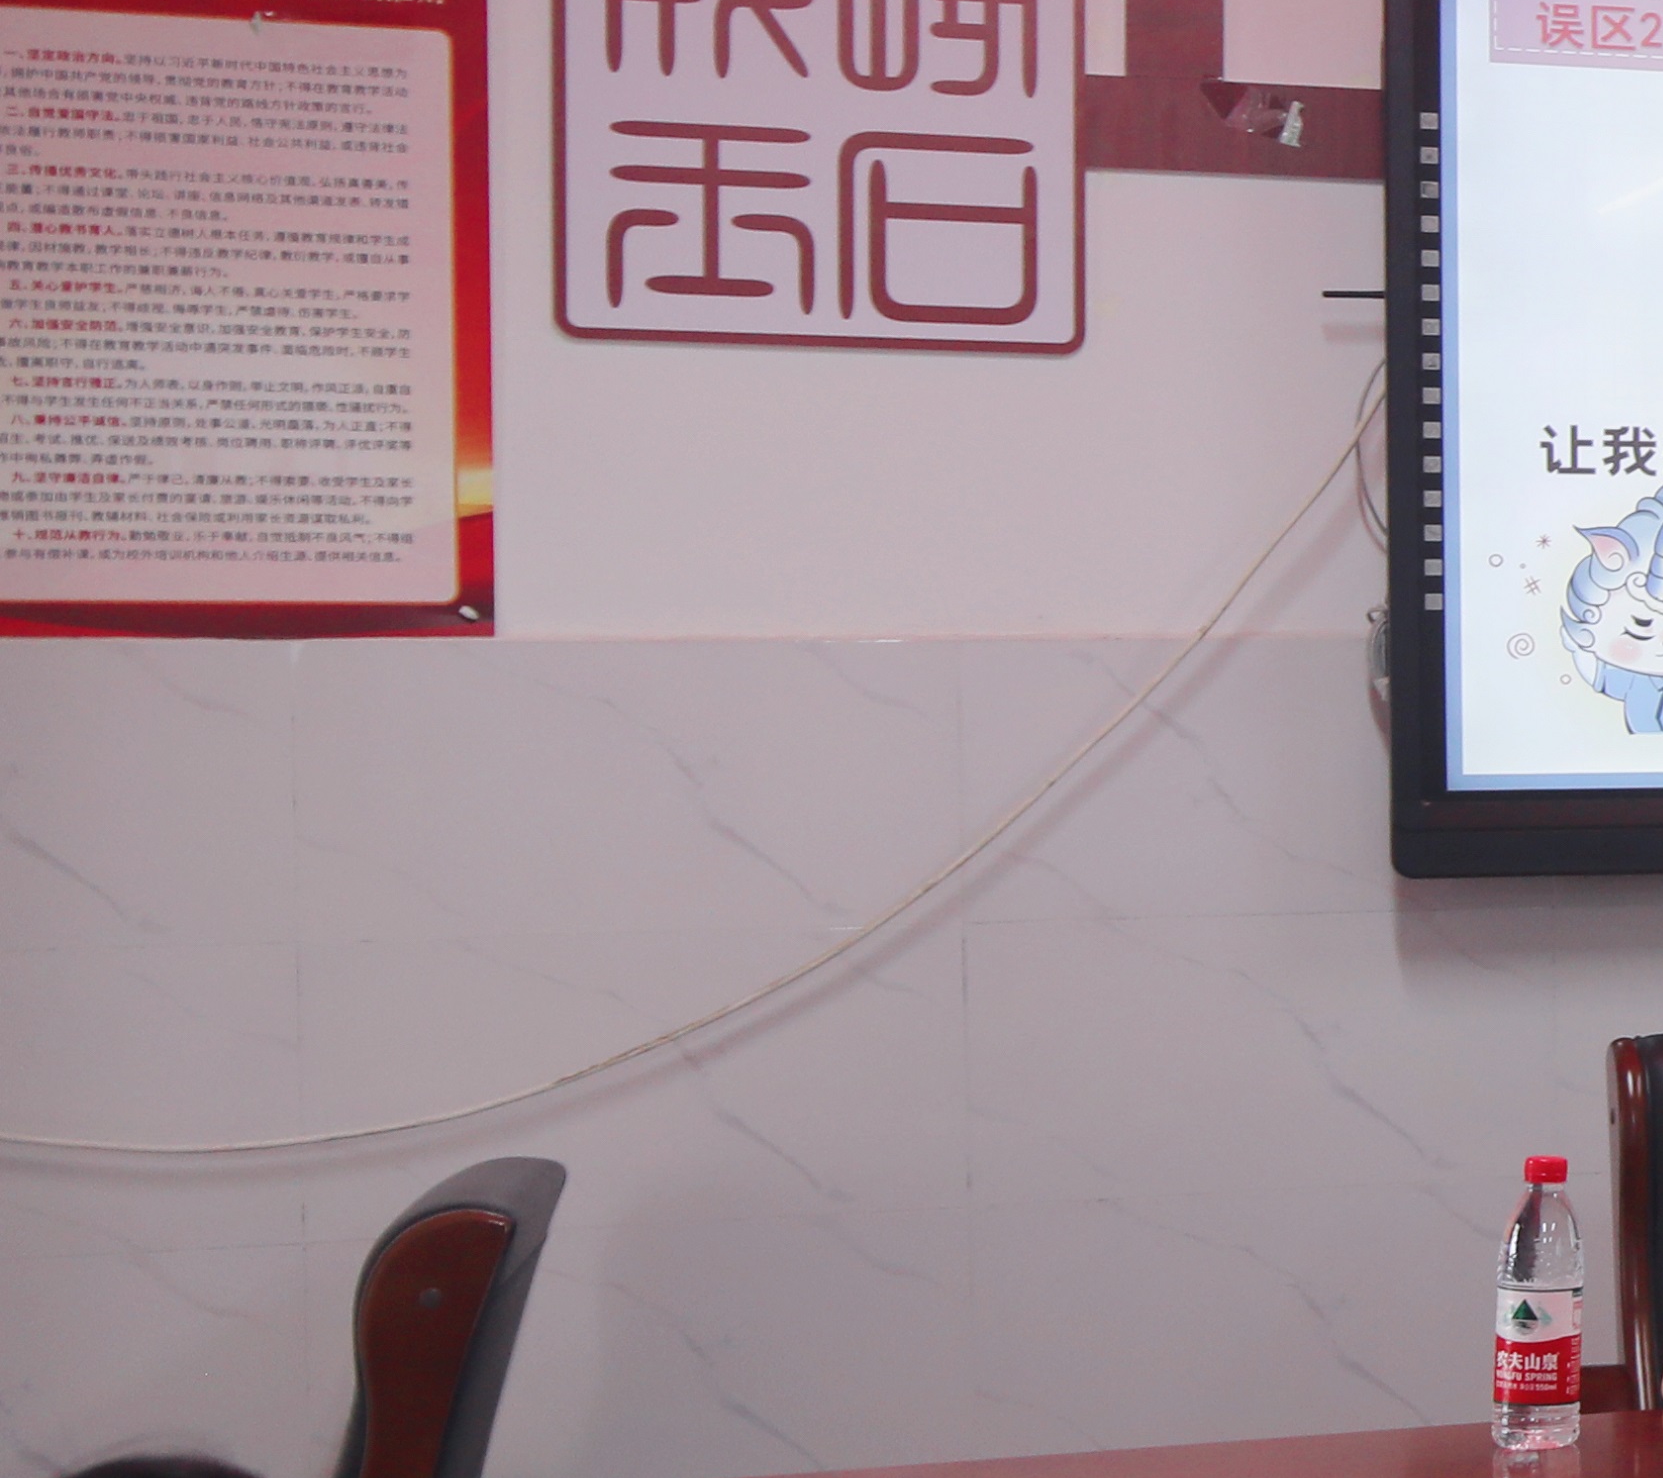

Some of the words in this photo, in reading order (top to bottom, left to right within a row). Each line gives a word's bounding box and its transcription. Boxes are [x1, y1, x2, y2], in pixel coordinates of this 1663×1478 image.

[1496, 1350, 1559, 1371] 农夫山泉
[1525, 1372, 1558, 1382] SPRING
